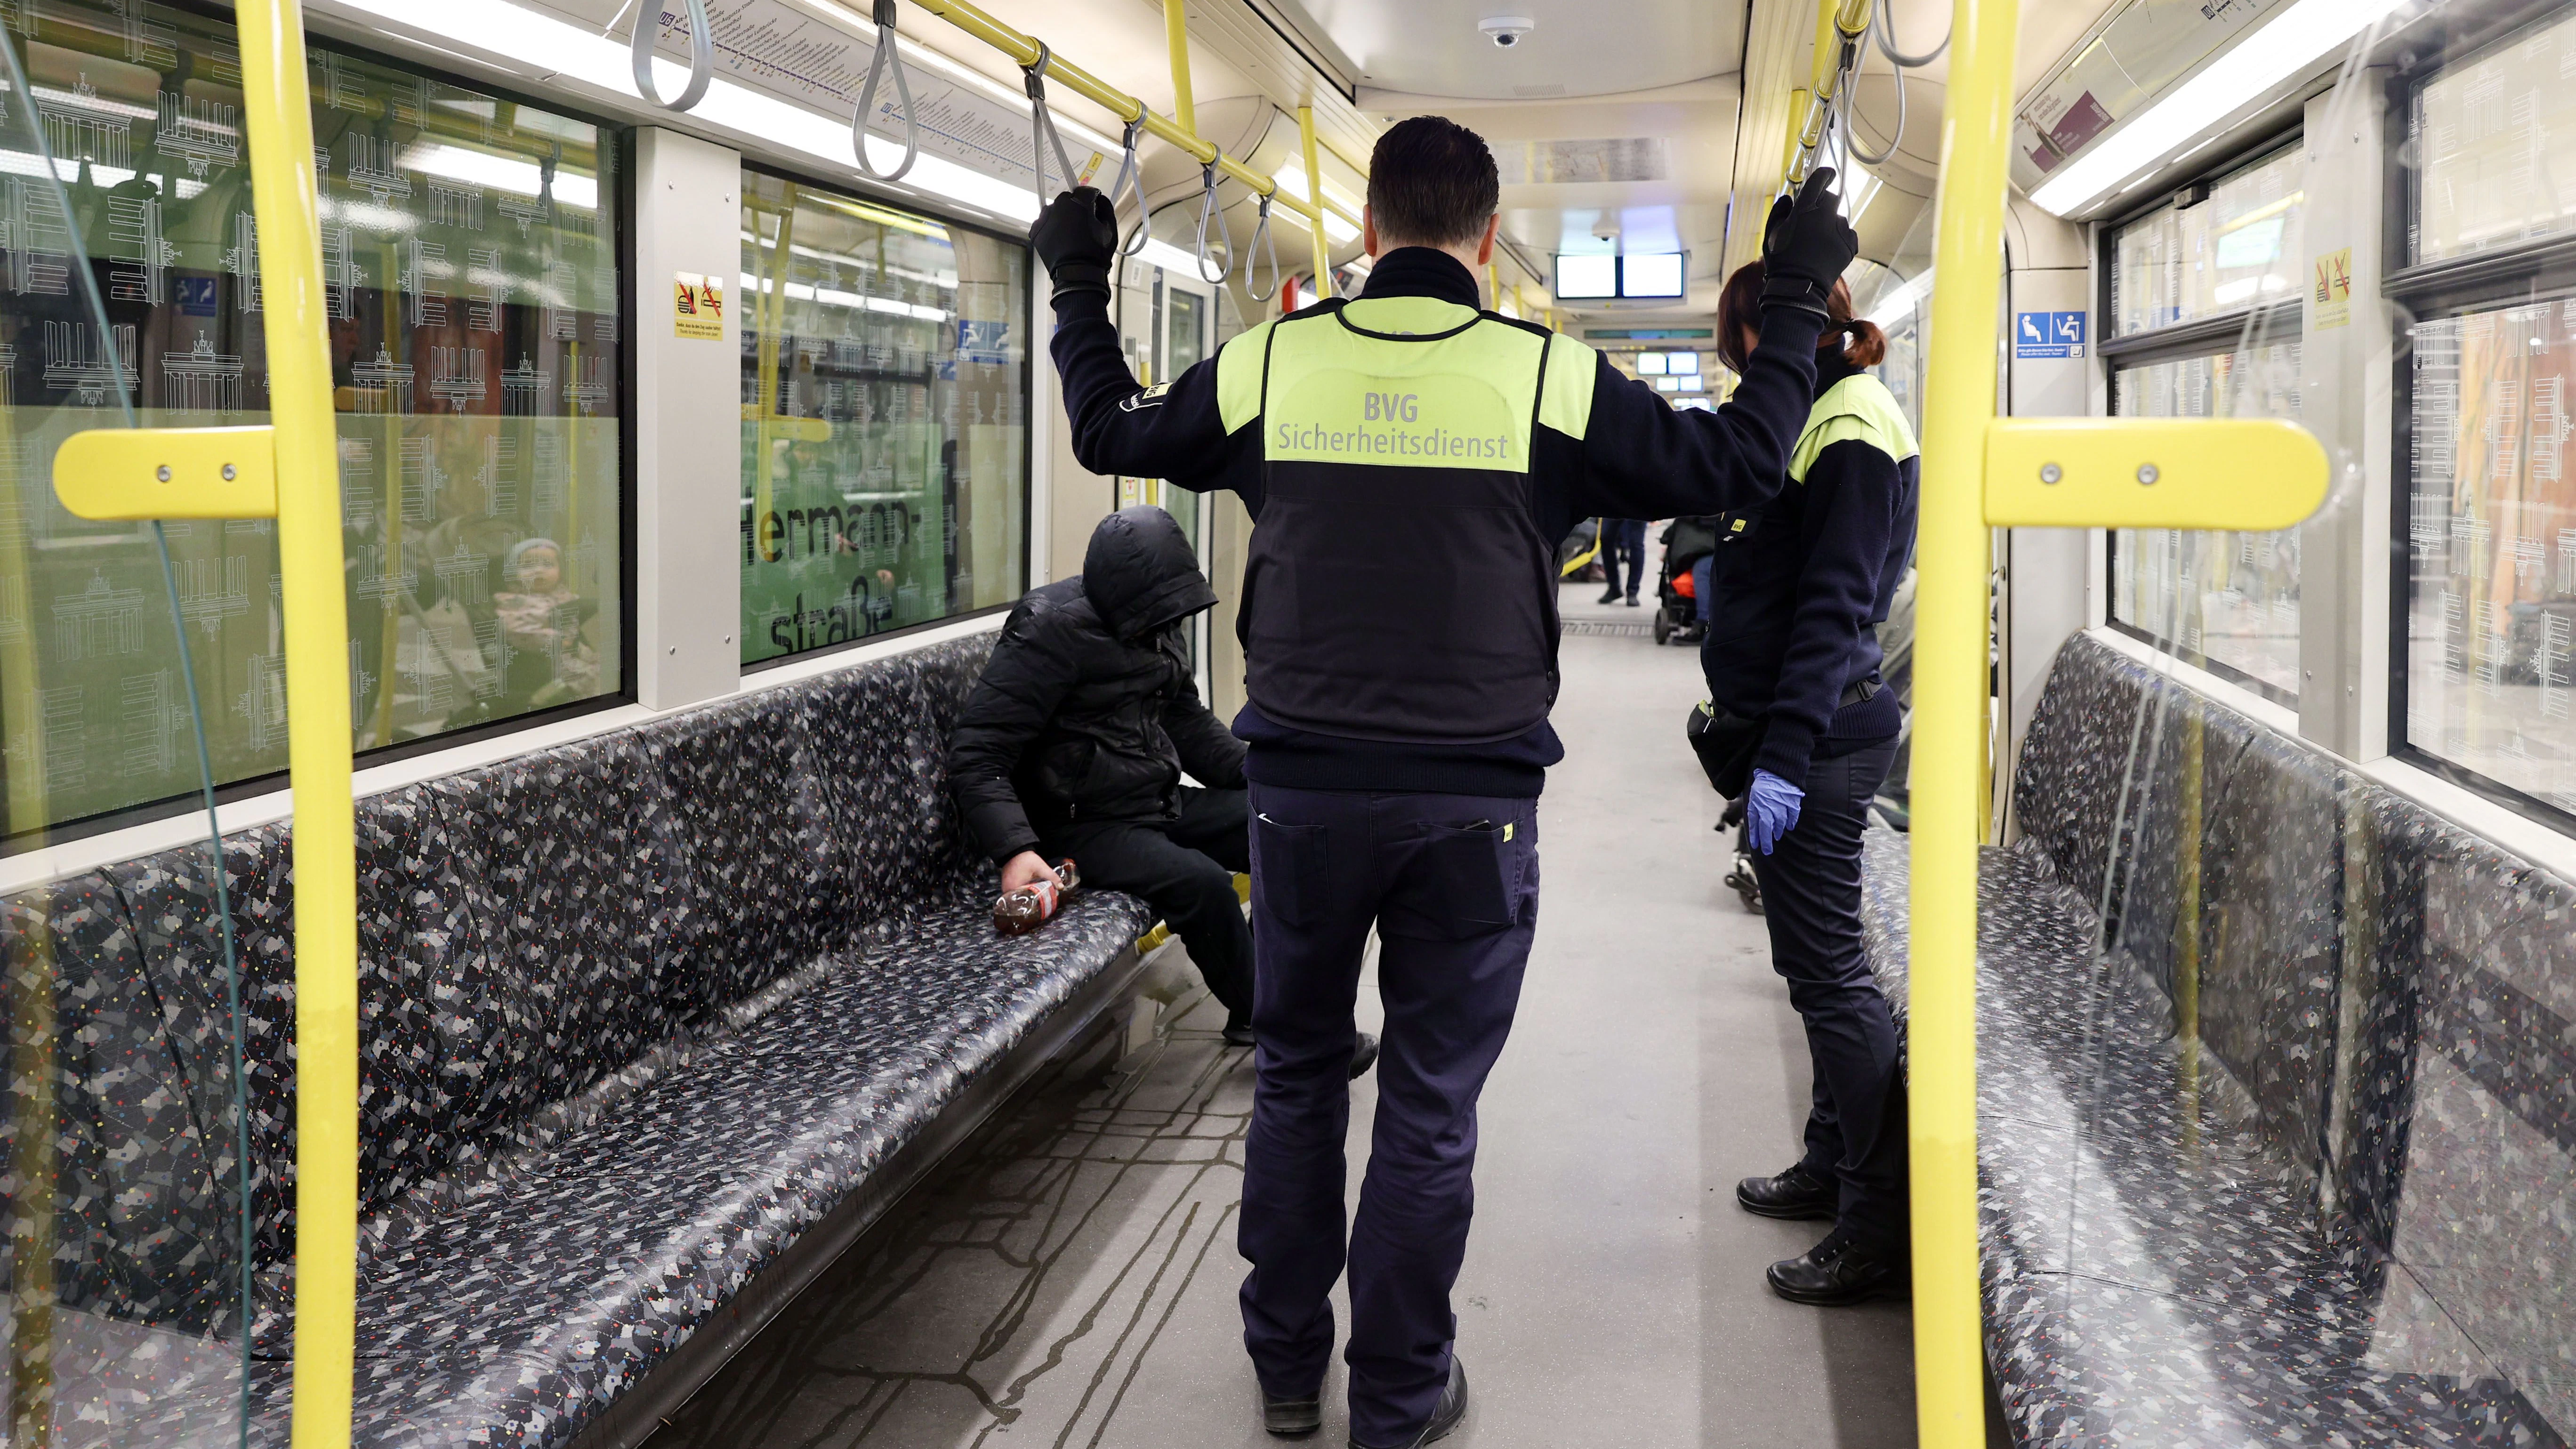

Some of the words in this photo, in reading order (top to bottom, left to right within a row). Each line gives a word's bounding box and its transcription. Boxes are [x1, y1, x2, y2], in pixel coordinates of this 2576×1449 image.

[660, 13, 674, 25] U6
[2202, 7, 2214, 18] U8
[716, 24, 741, 41] Tempelhof
[725, 24, 755, 44] Paradestraße
[733, 39, 745, 48] Platz
[754, 18, 777, 35] Luftbrücke
[741, 29, 773, 50] Mehringdamm
[748, 38, 772, 54] Hallesches
[756, 40, 780, 56] Kochstraße
[763, 43, 787, 60] Stadtmitte
[792, 38, 806, 49] Linden
[1146, 386, 1160, 396] BVG
[1365, 393, 1418, 422] BVG
[1279, 423, 1508, 459] Sicherheitsdienst
